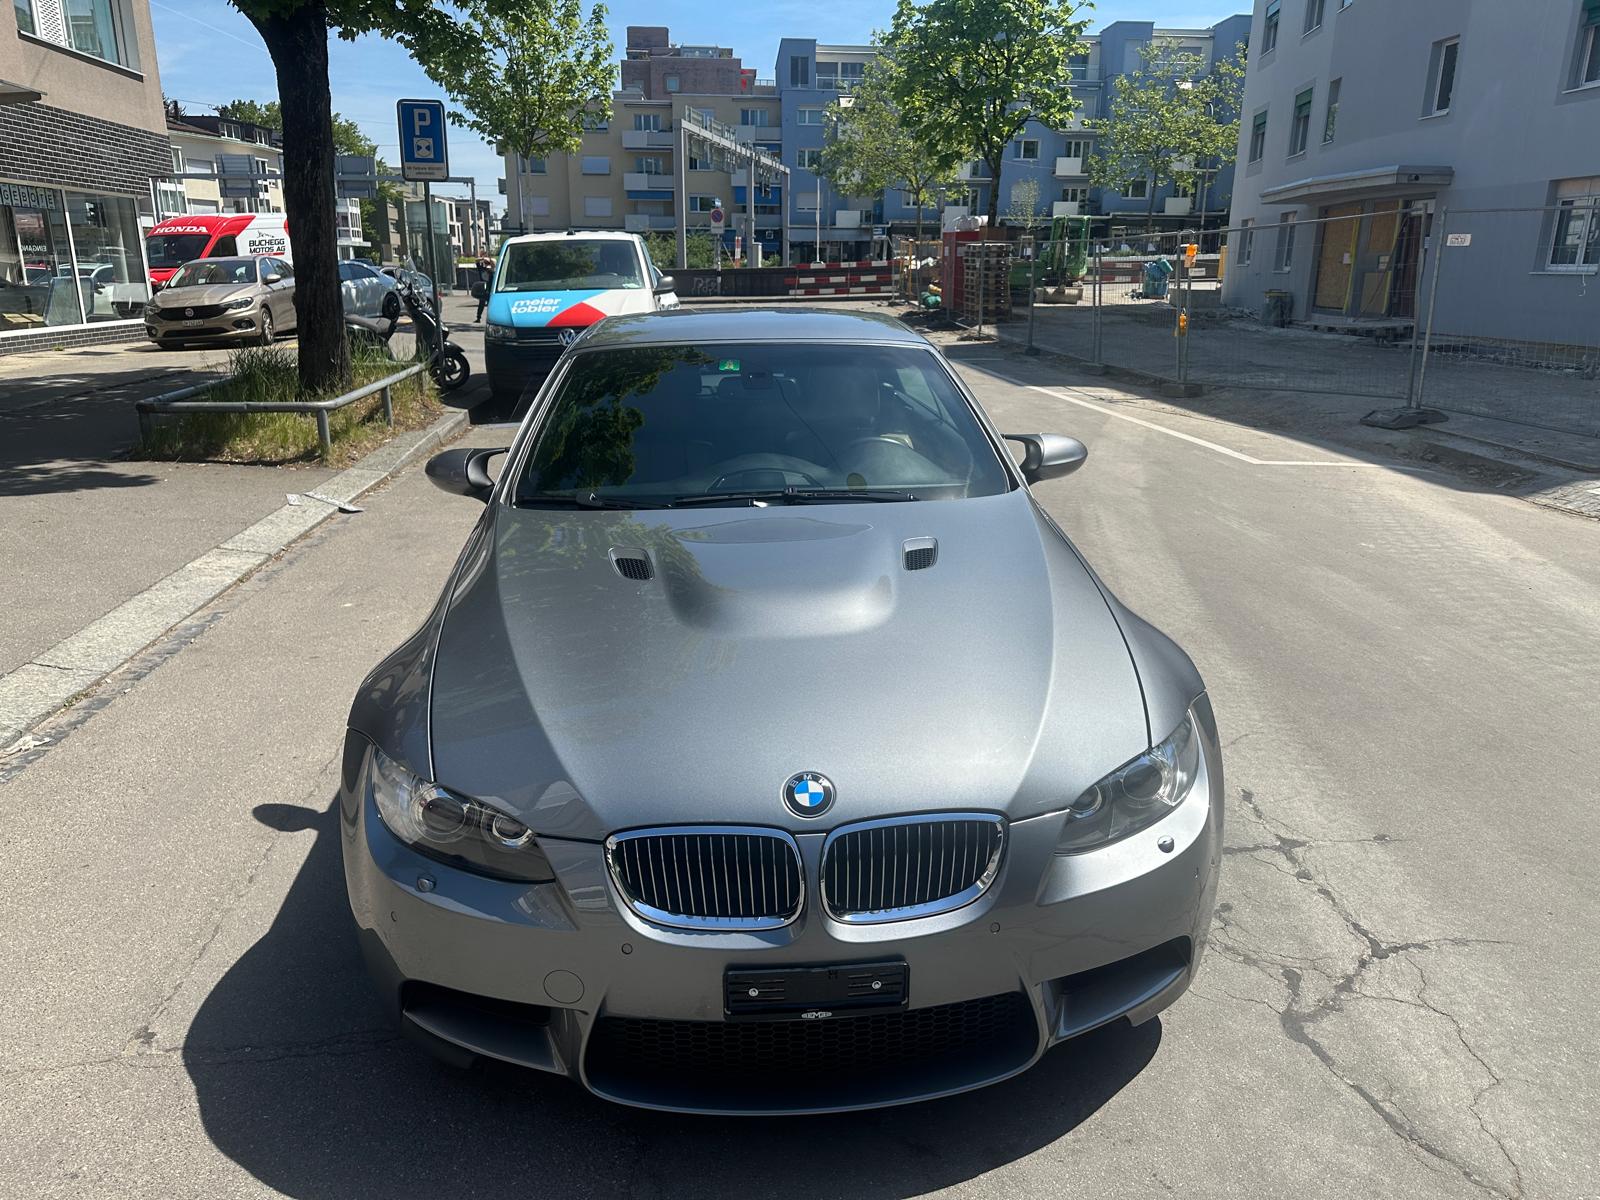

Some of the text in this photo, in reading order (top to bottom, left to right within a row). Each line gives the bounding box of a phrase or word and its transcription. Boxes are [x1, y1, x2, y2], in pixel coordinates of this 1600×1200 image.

[413, 108, 431, 136] P
[154, 225, 208, 234] HONDA
[248, 238, 285, 247] BUCHEGG
[514, 297, 561, 306] meier
[511, 304, 559, 314] tobler
